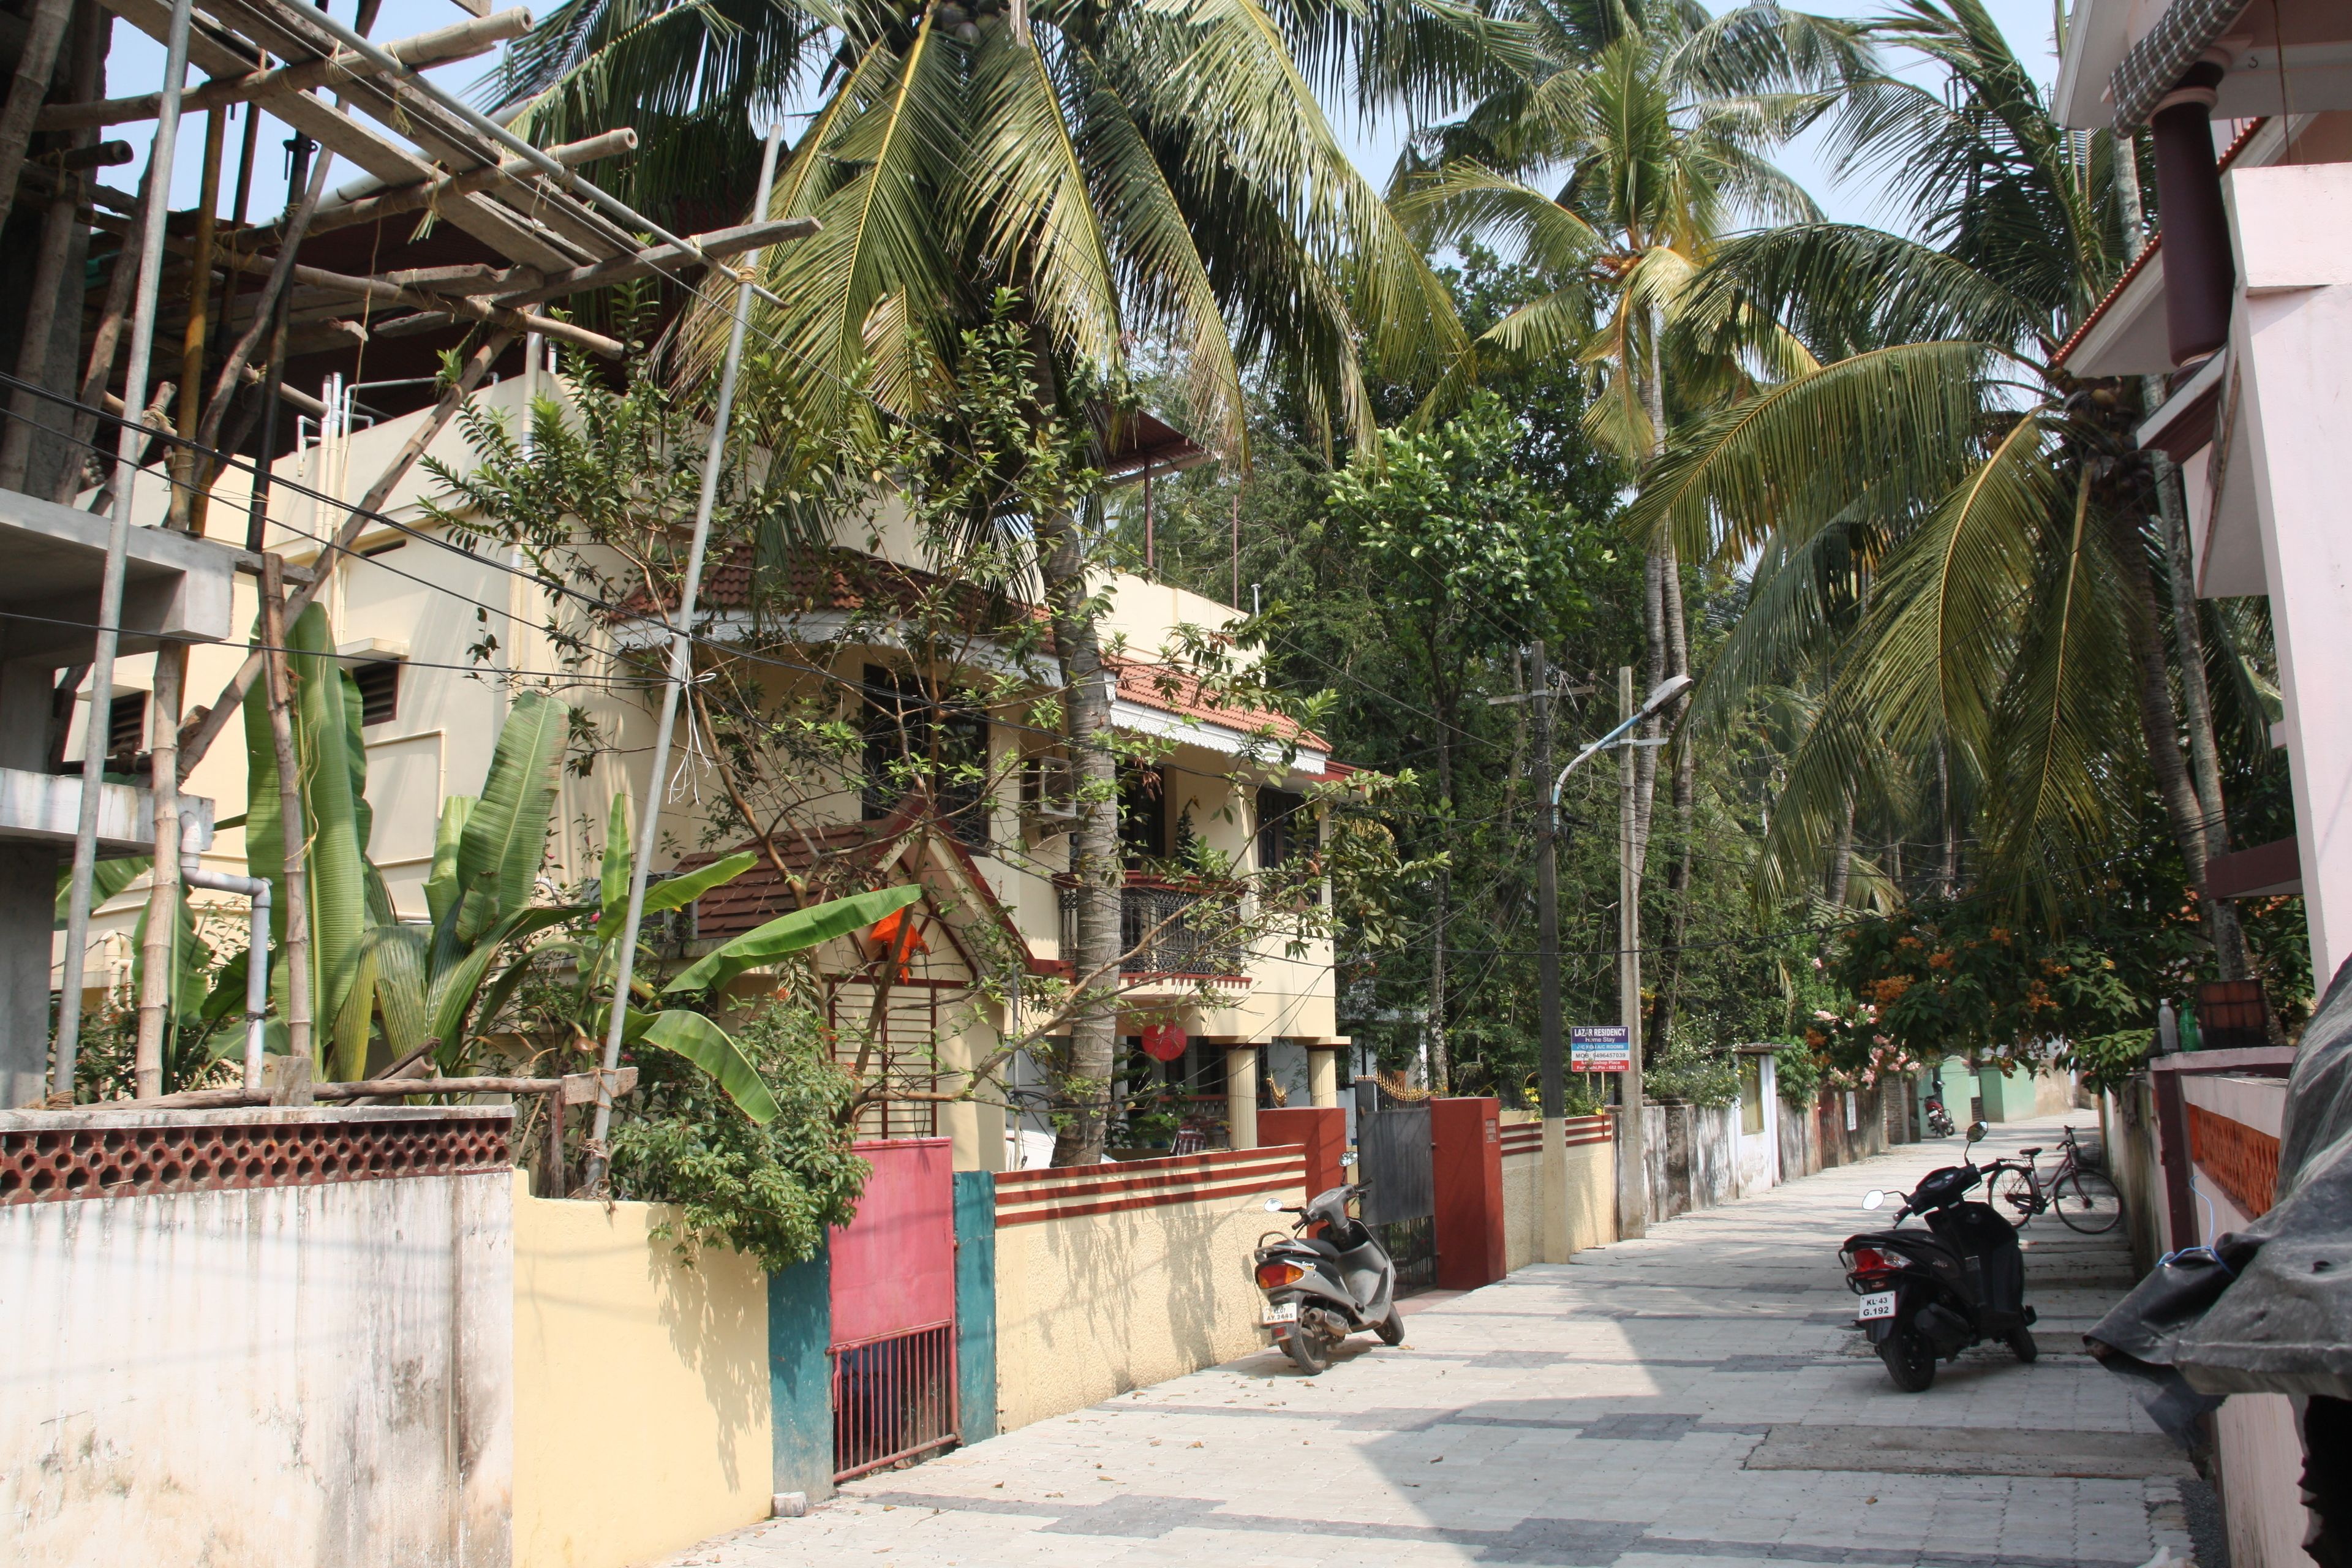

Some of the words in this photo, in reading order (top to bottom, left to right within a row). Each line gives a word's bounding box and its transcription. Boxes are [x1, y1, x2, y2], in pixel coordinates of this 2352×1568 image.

[1574, 1028, 1593, 1037] LAZAR
[1594, 1028, 1626, 1036] RESIDENCY
[1866, 1297, 1887, 1306] KL-43
[1863, 1306, 1889, 1316] G.192
